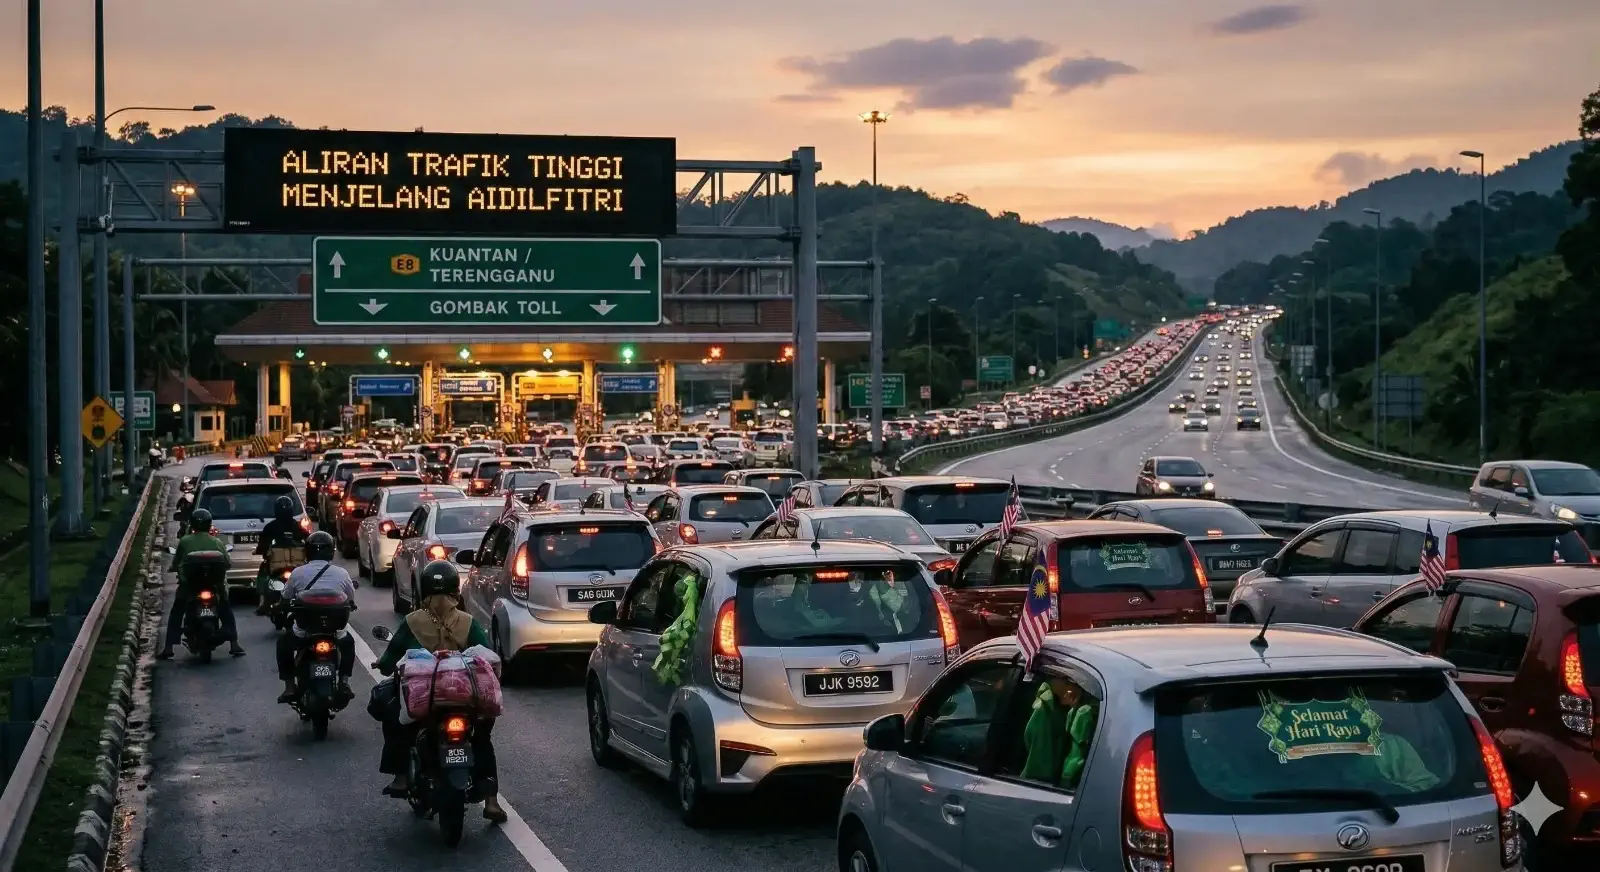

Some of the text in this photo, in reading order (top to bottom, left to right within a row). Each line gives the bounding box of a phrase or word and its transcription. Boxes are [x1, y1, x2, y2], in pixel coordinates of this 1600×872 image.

[282, 149, 623, 180] ALIRAN TRAFIK TINGGI
[282, 183, 623, 213] MENJELANG AIDILFITRI
[430, 247, 518, 262] KUANTAN
[397, 259, 414, 271] E8
[430, 268, 555, 283] TERENGGANU
[430, 300, 562, 315] GOMBAK TOLL
[819, 675, 880, 691] JJK 9592
[1290, 708, 1348, 724] Selamat
[1285, 723, 1361, 741] Hari Raya
